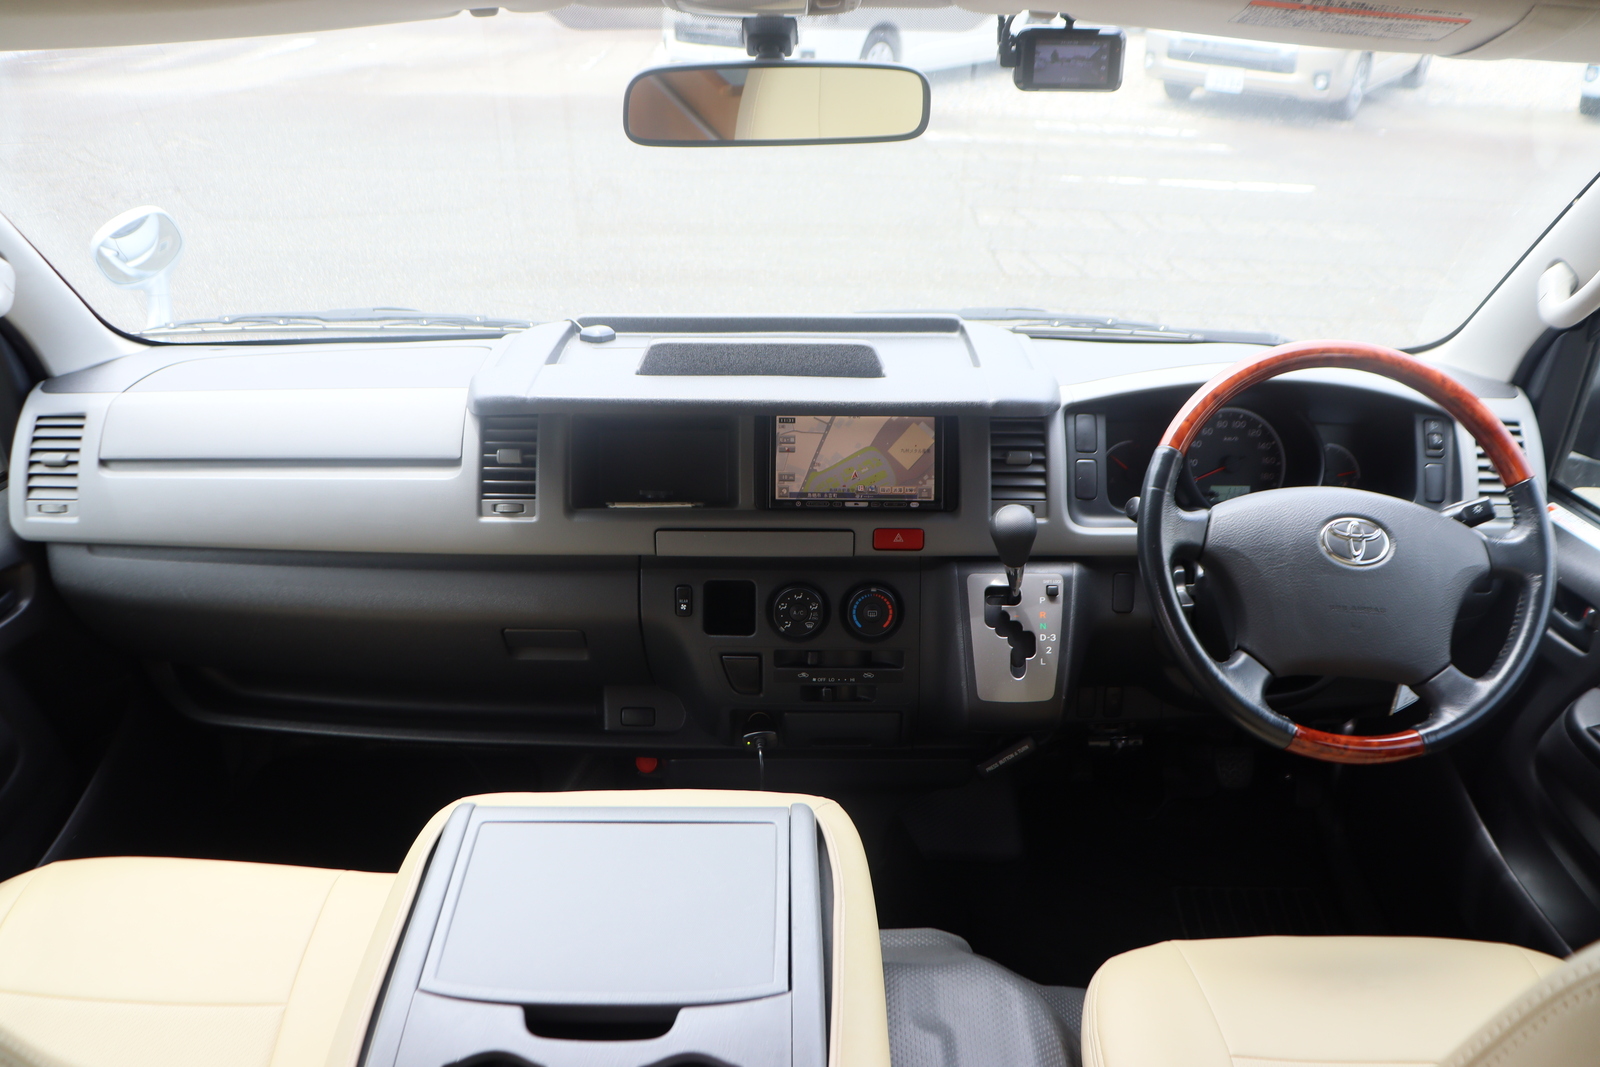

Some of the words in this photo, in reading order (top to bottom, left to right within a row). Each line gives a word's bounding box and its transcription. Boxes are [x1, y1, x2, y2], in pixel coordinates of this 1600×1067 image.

[1216, 420, 1229, 429] 80
[1232, 420, 1247, 429] 100
[1202, 427, 1214, 436] 60
[1248, 428, 1262, 437] 120
[1258, 441, 1271, 449] 140
[1262, 456, 1276, 464] 160
[1260, 472, 1274, 480] 180
[1039, 611, 1046, 619] R
[1039, 633, 1057, 642] D-3
[1045, 646, 1052, 654] 2
[1040, 658, 1046, 666] L
